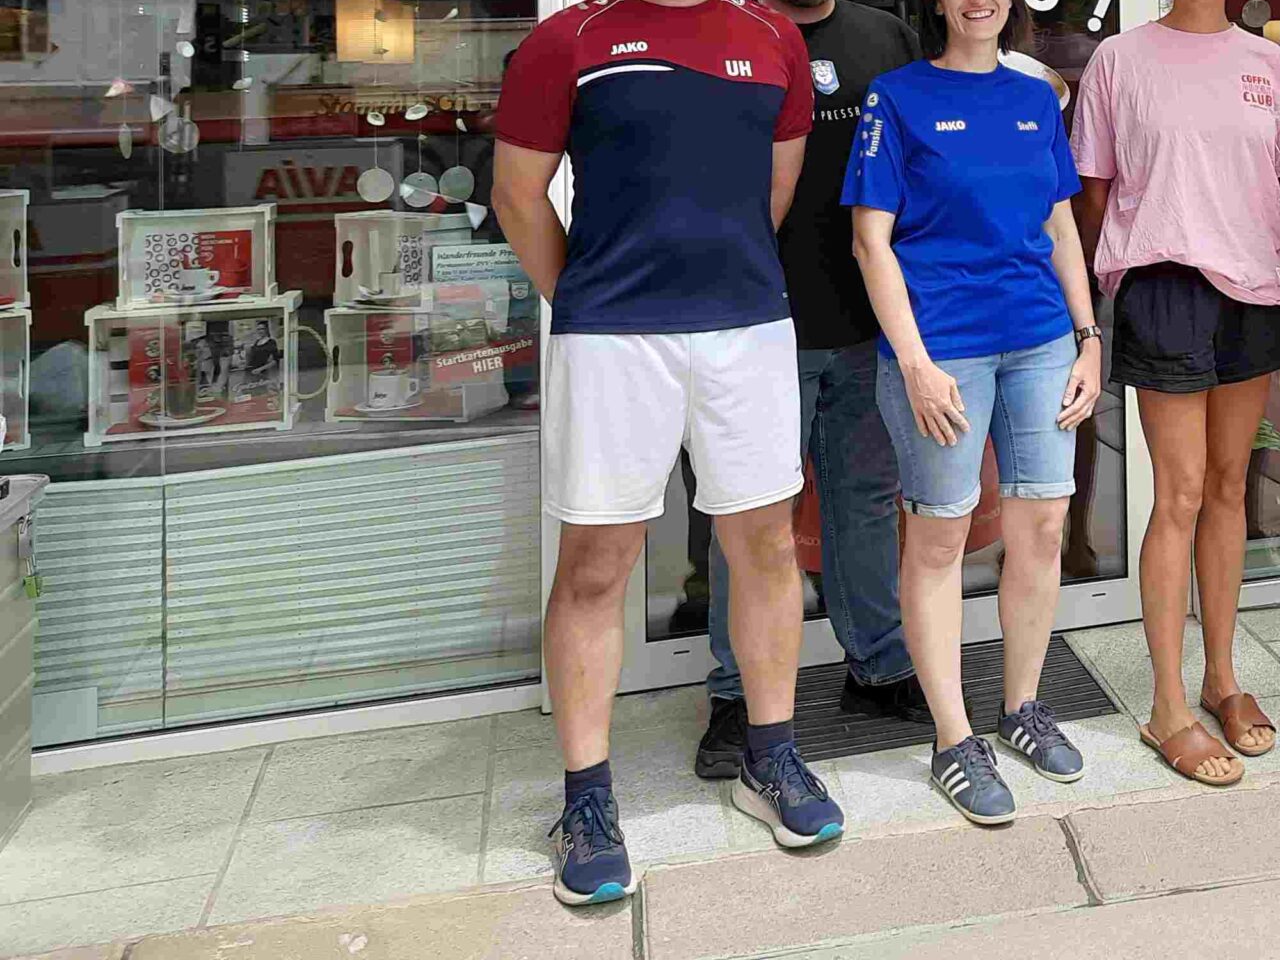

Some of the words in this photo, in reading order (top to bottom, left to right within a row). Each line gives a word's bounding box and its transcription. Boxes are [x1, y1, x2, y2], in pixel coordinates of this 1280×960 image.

[610, 41, 648, 56] JAKO
[725, 60, 753, 77] UH
[1243, 91, 1273, 107] CLUB
[820, 106, 861, 121] PRESSA
[935, 120, 966, 132] JAKO
[865, 119, 884, 158] Fanshirt
[435, 338, 534, 368] Startkartenausgabe
[473, 356, 504, 374] HIER
